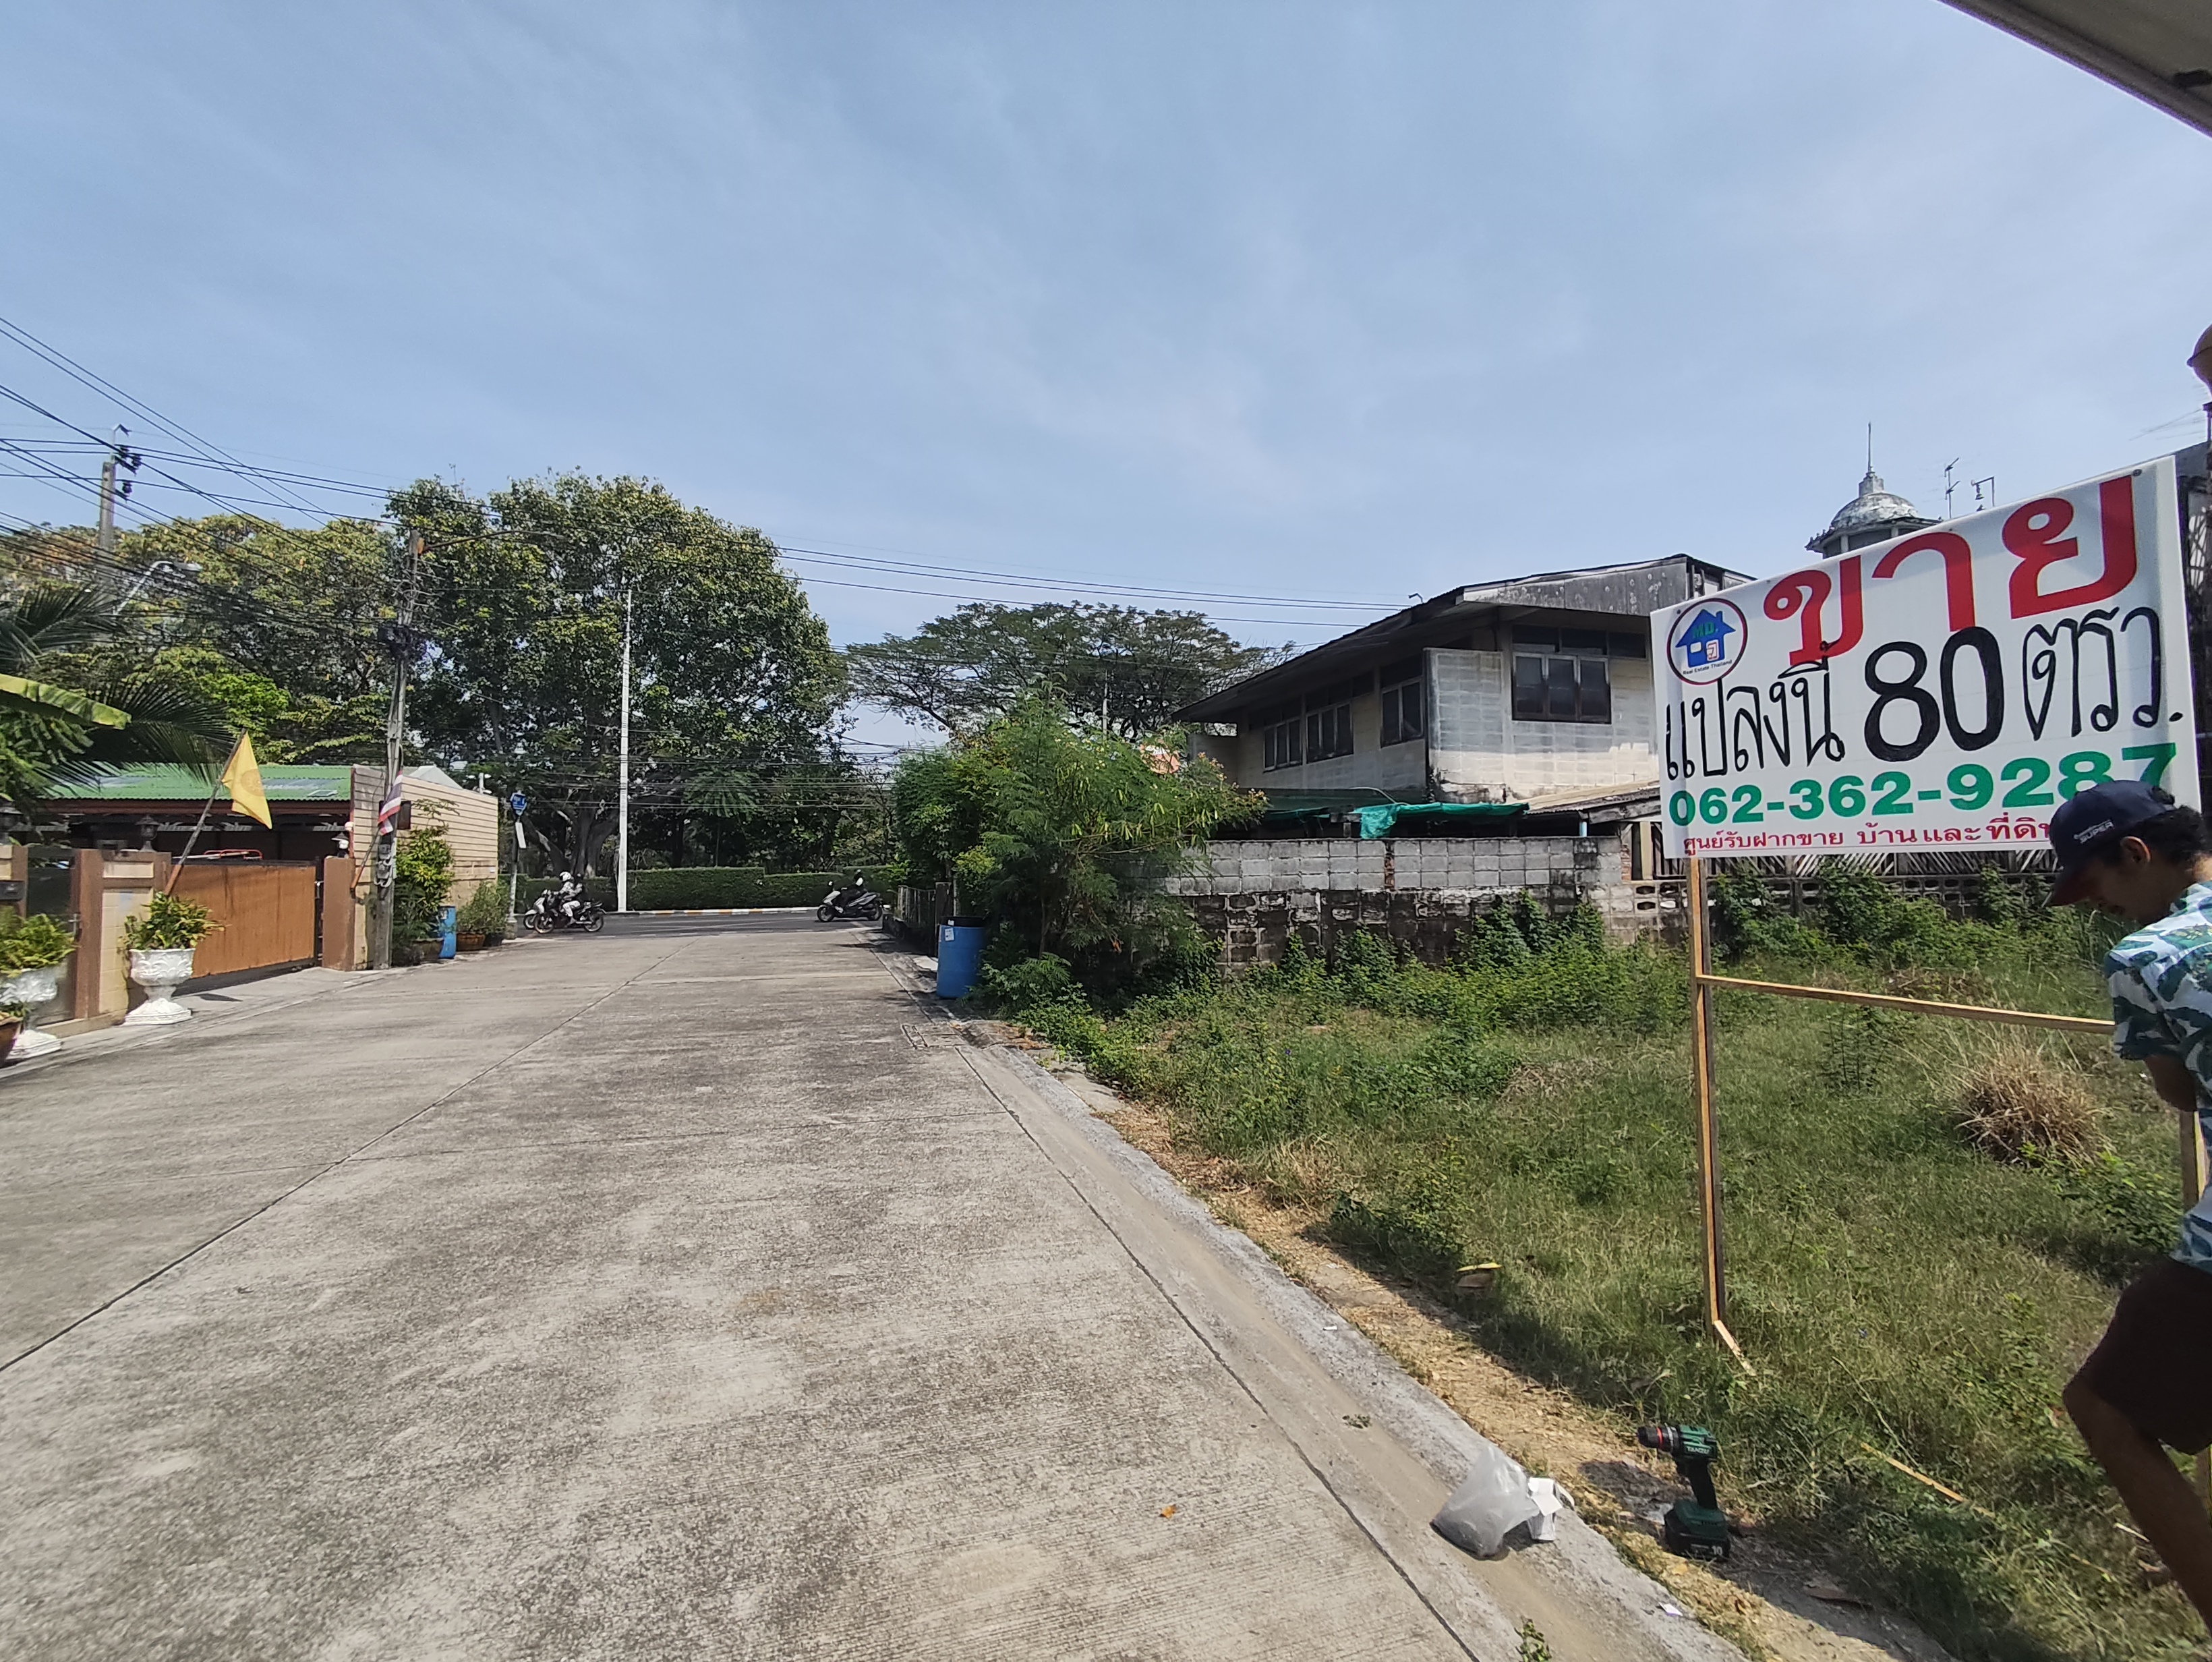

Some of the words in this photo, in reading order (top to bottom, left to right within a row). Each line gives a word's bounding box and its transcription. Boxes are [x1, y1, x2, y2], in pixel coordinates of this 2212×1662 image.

[1764, 475, 2137, 665] ขาย
[1711, 659, 1733, 669] Thailand
[1864, 627, 2004, 762] 80
